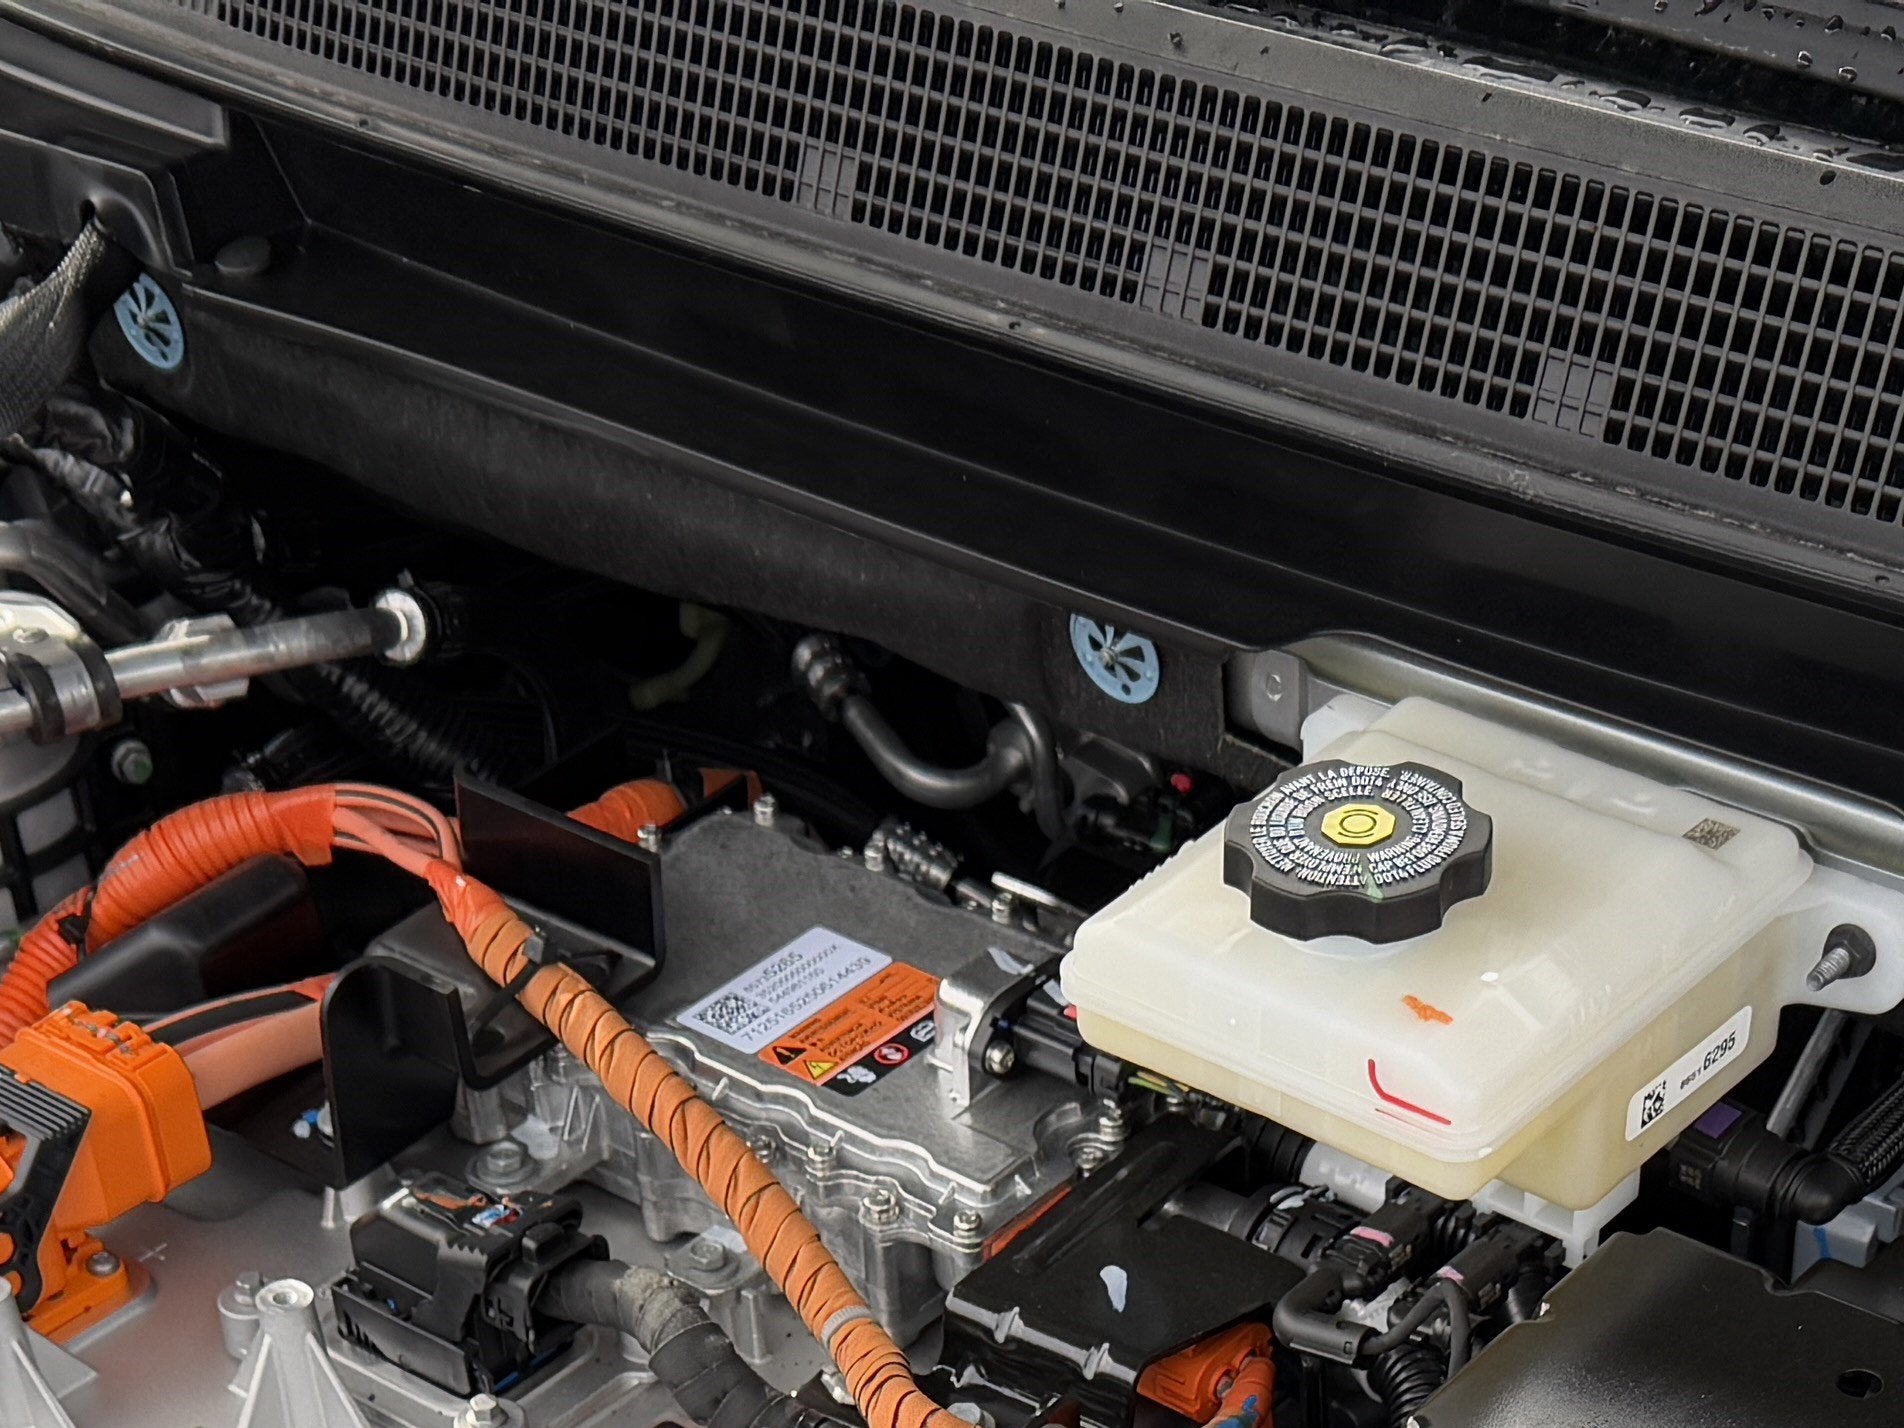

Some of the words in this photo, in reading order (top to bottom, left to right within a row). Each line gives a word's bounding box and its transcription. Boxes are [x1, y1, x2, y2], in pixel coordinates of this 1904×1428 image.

[1276, 773, 1317, 795] AVANT
[1316, 768, 1337, 780] LA
[1368, 859, 1397, 873] CAP
[1703, 1031, 1736, 1070] 6295
